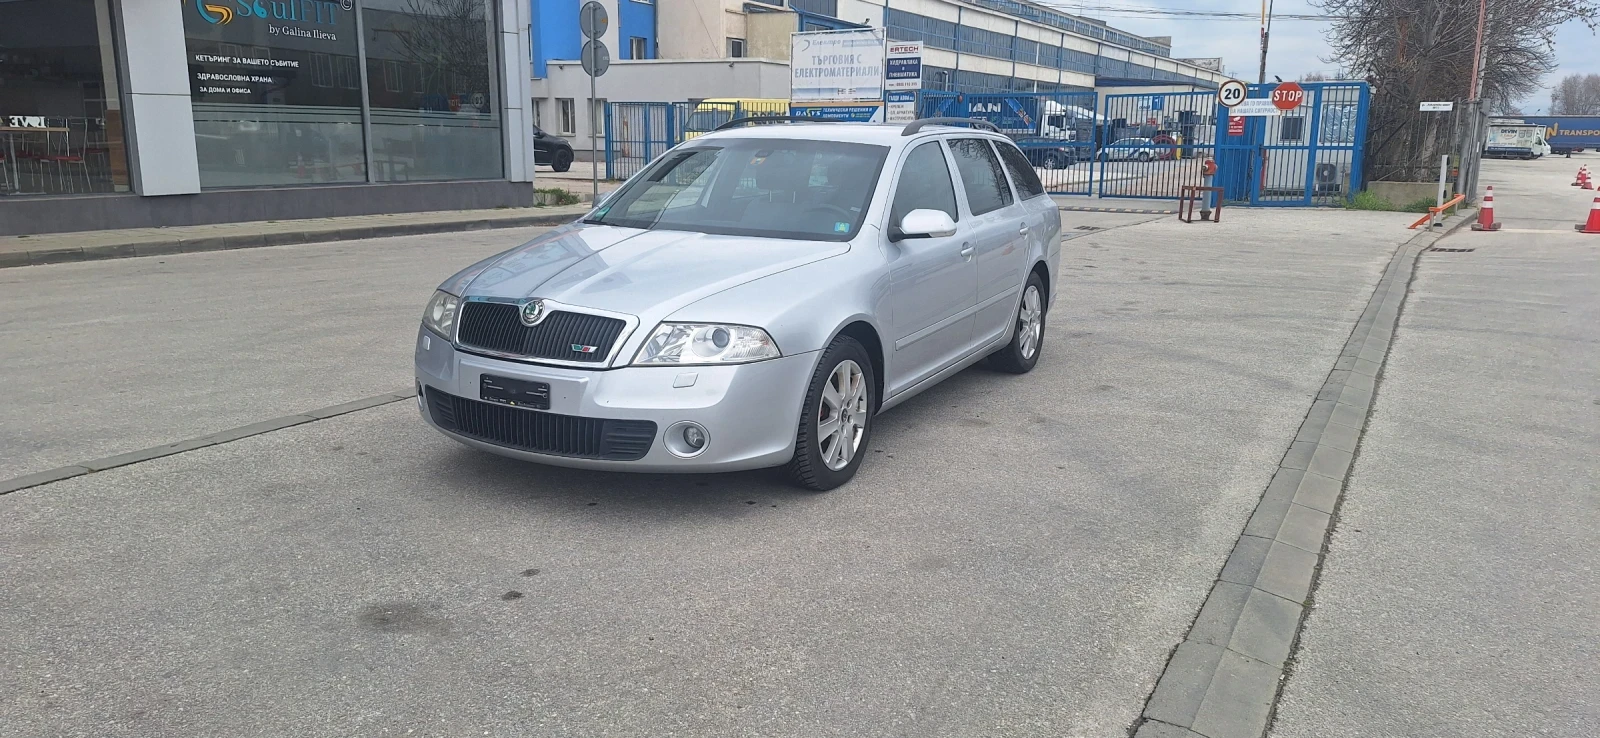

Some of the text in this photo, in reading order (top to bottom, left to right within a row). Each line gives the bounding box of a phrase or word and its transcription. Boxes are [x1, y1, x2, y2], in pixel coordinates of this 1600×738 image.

[269, 24, 337, 41] by Galina Ilieva
[195, 54, 300, 68] КЕТЪРИНГ ЗА ВАШЕТО СЪБИТИЕ
[811, 54, 854, 66] ТЪРГОВИЯ
[196, 72, 273, 83] ЗДРАВОСЛОВНА ХРАНА
[794, 66, 880, 78] ЕЛЕКТРОМАТЕРИАЛИ
[1224, 88, 1241, 100] 20
[1273, 90, 1303, 102] STOP
